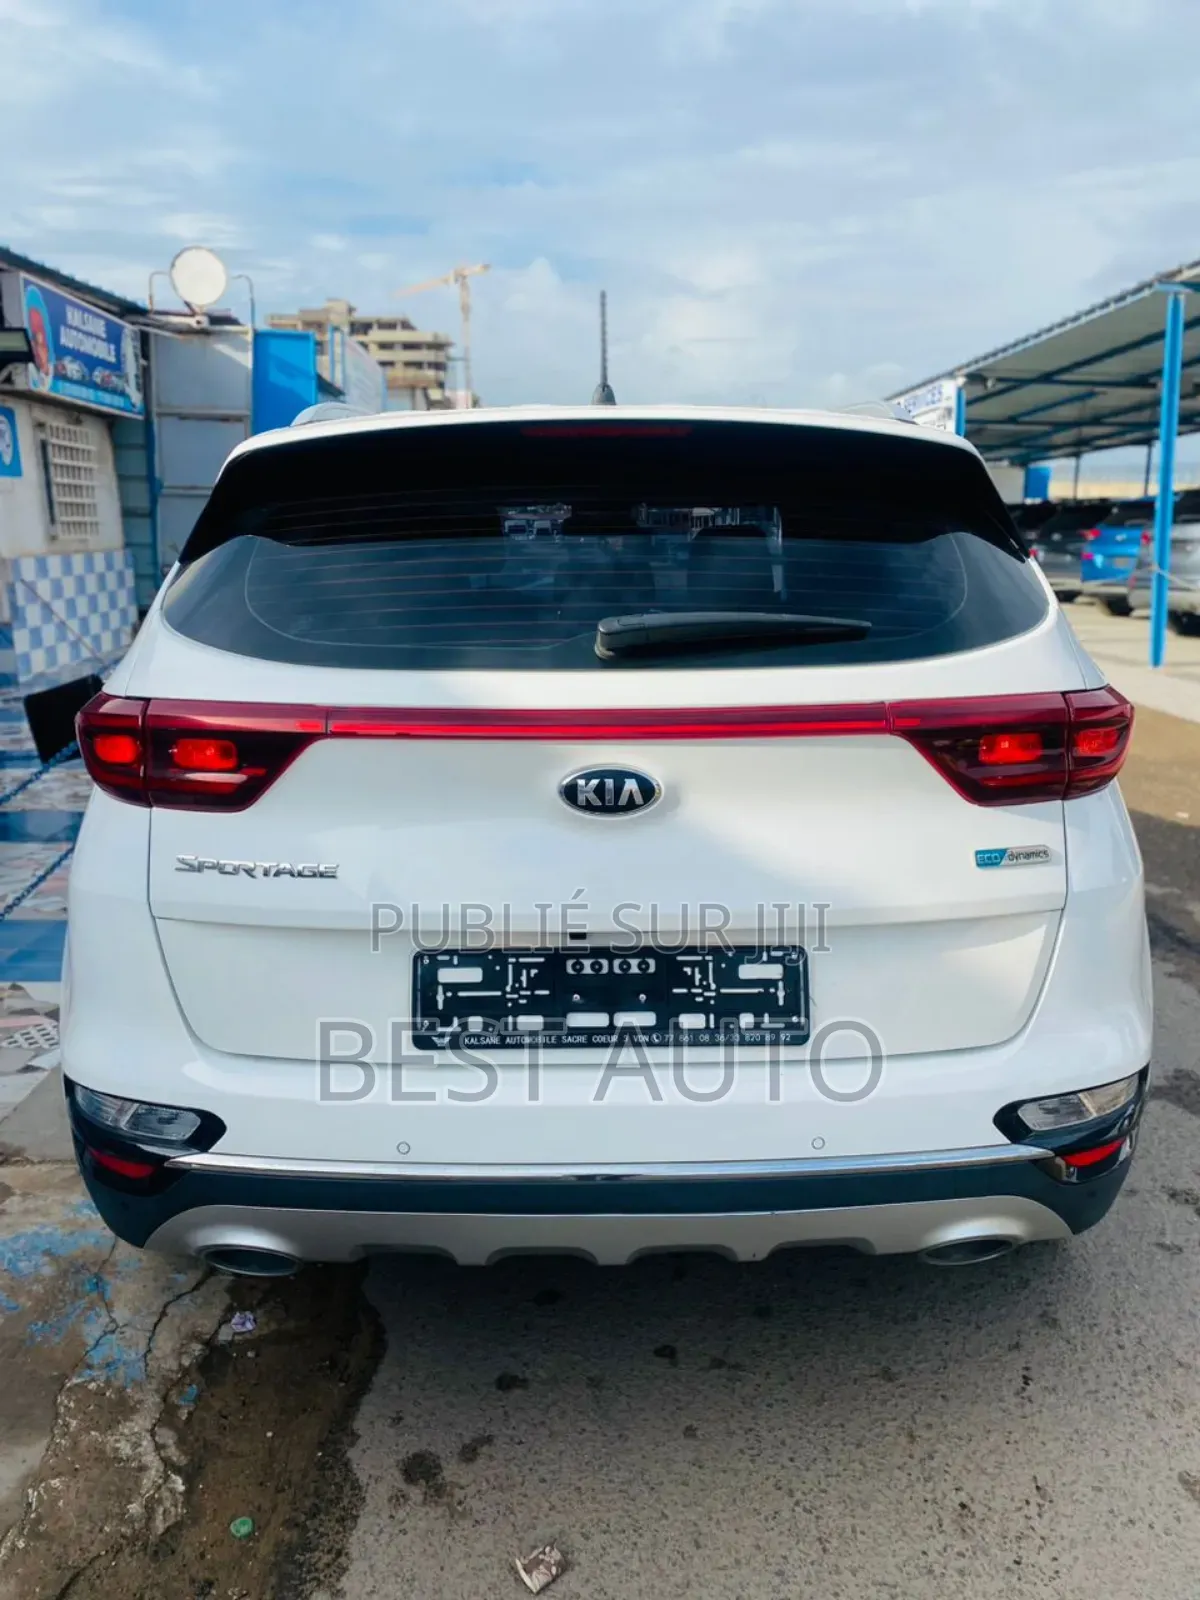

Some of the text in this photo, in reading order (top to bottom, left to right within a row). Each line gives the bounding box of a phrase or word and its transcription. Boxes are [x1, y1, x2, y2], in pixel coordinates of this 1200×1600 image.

[576, 778, 644, 806] KIA
[977, 848, 1049, 864] ECO dynamics
[464, 1035, 500, 1045] KALSANE
[505, 1034, 557, 1044] AUTOMOBILE
[561, 1034, 587, 1044] SACRE
[592, 1033, 618, 1043] COEUR
[633, 1033, 650, 1043] VDN
[780, 1031, 791, 1041] 92
